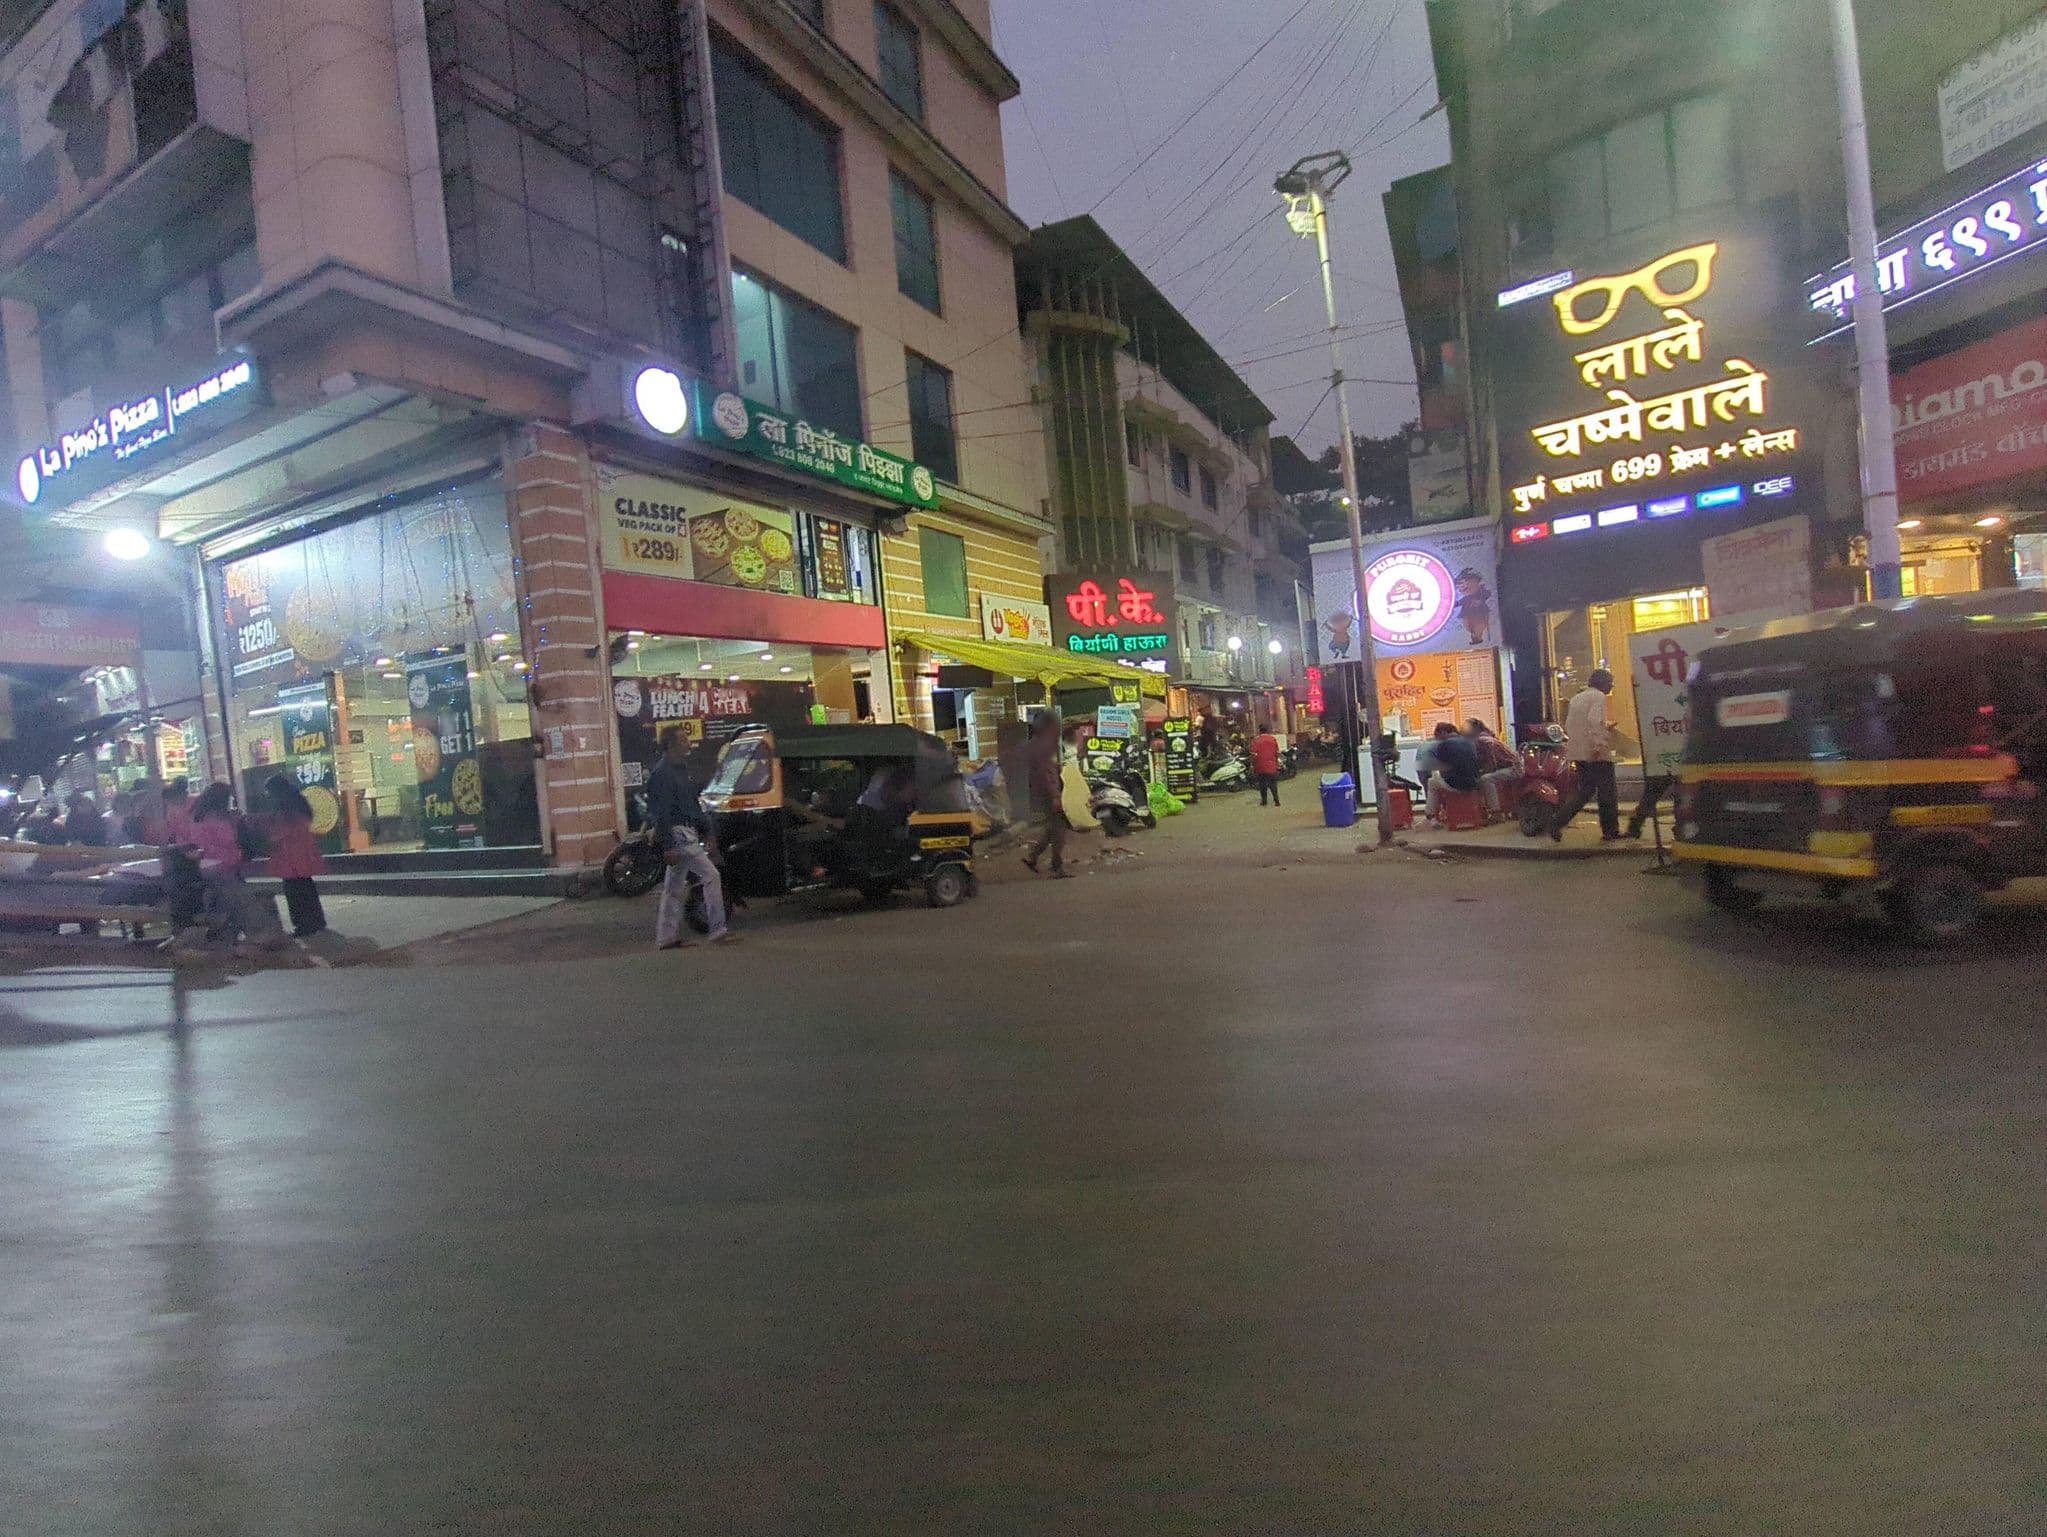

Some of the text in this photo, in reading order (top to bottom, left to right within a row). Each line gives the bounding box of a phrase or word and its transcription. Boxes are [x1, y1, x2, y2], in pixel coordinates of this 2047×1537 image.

[1574, 307, 1704, 387] लाले
[1530, 359, 1769, 456] चष्मेवाले
[1890, 360, 2047, 433] iamo
[39, 446, 61, 477] La
[61, 418, 109, 470] Pino'z
[109, 398, 159, 445] Pizza
[1611, 453, 1662, 483] 699
[1669, 446, 1710, 475] फ्रेम
[1738, 428, 1797, 458] लेन्स
[1753, 477, 1793, 494] IDEE
[615, 497, 686, 523] CLASSIC
[617, 518, 637, 530] VEG
[639, 521, 662, 534] PACK
[664, 523, 676, 534] OF
[1369, 553, 1431, 579] PUROHIT
[1067, 633, 1120, 653] बिर्याणी
[650, 690, 694, 705] LUNCH
[1306, 665, 1324, 713] BAR
[293, 731, 326, 754] PIZZA
[439, 733, 461, 755] GET
